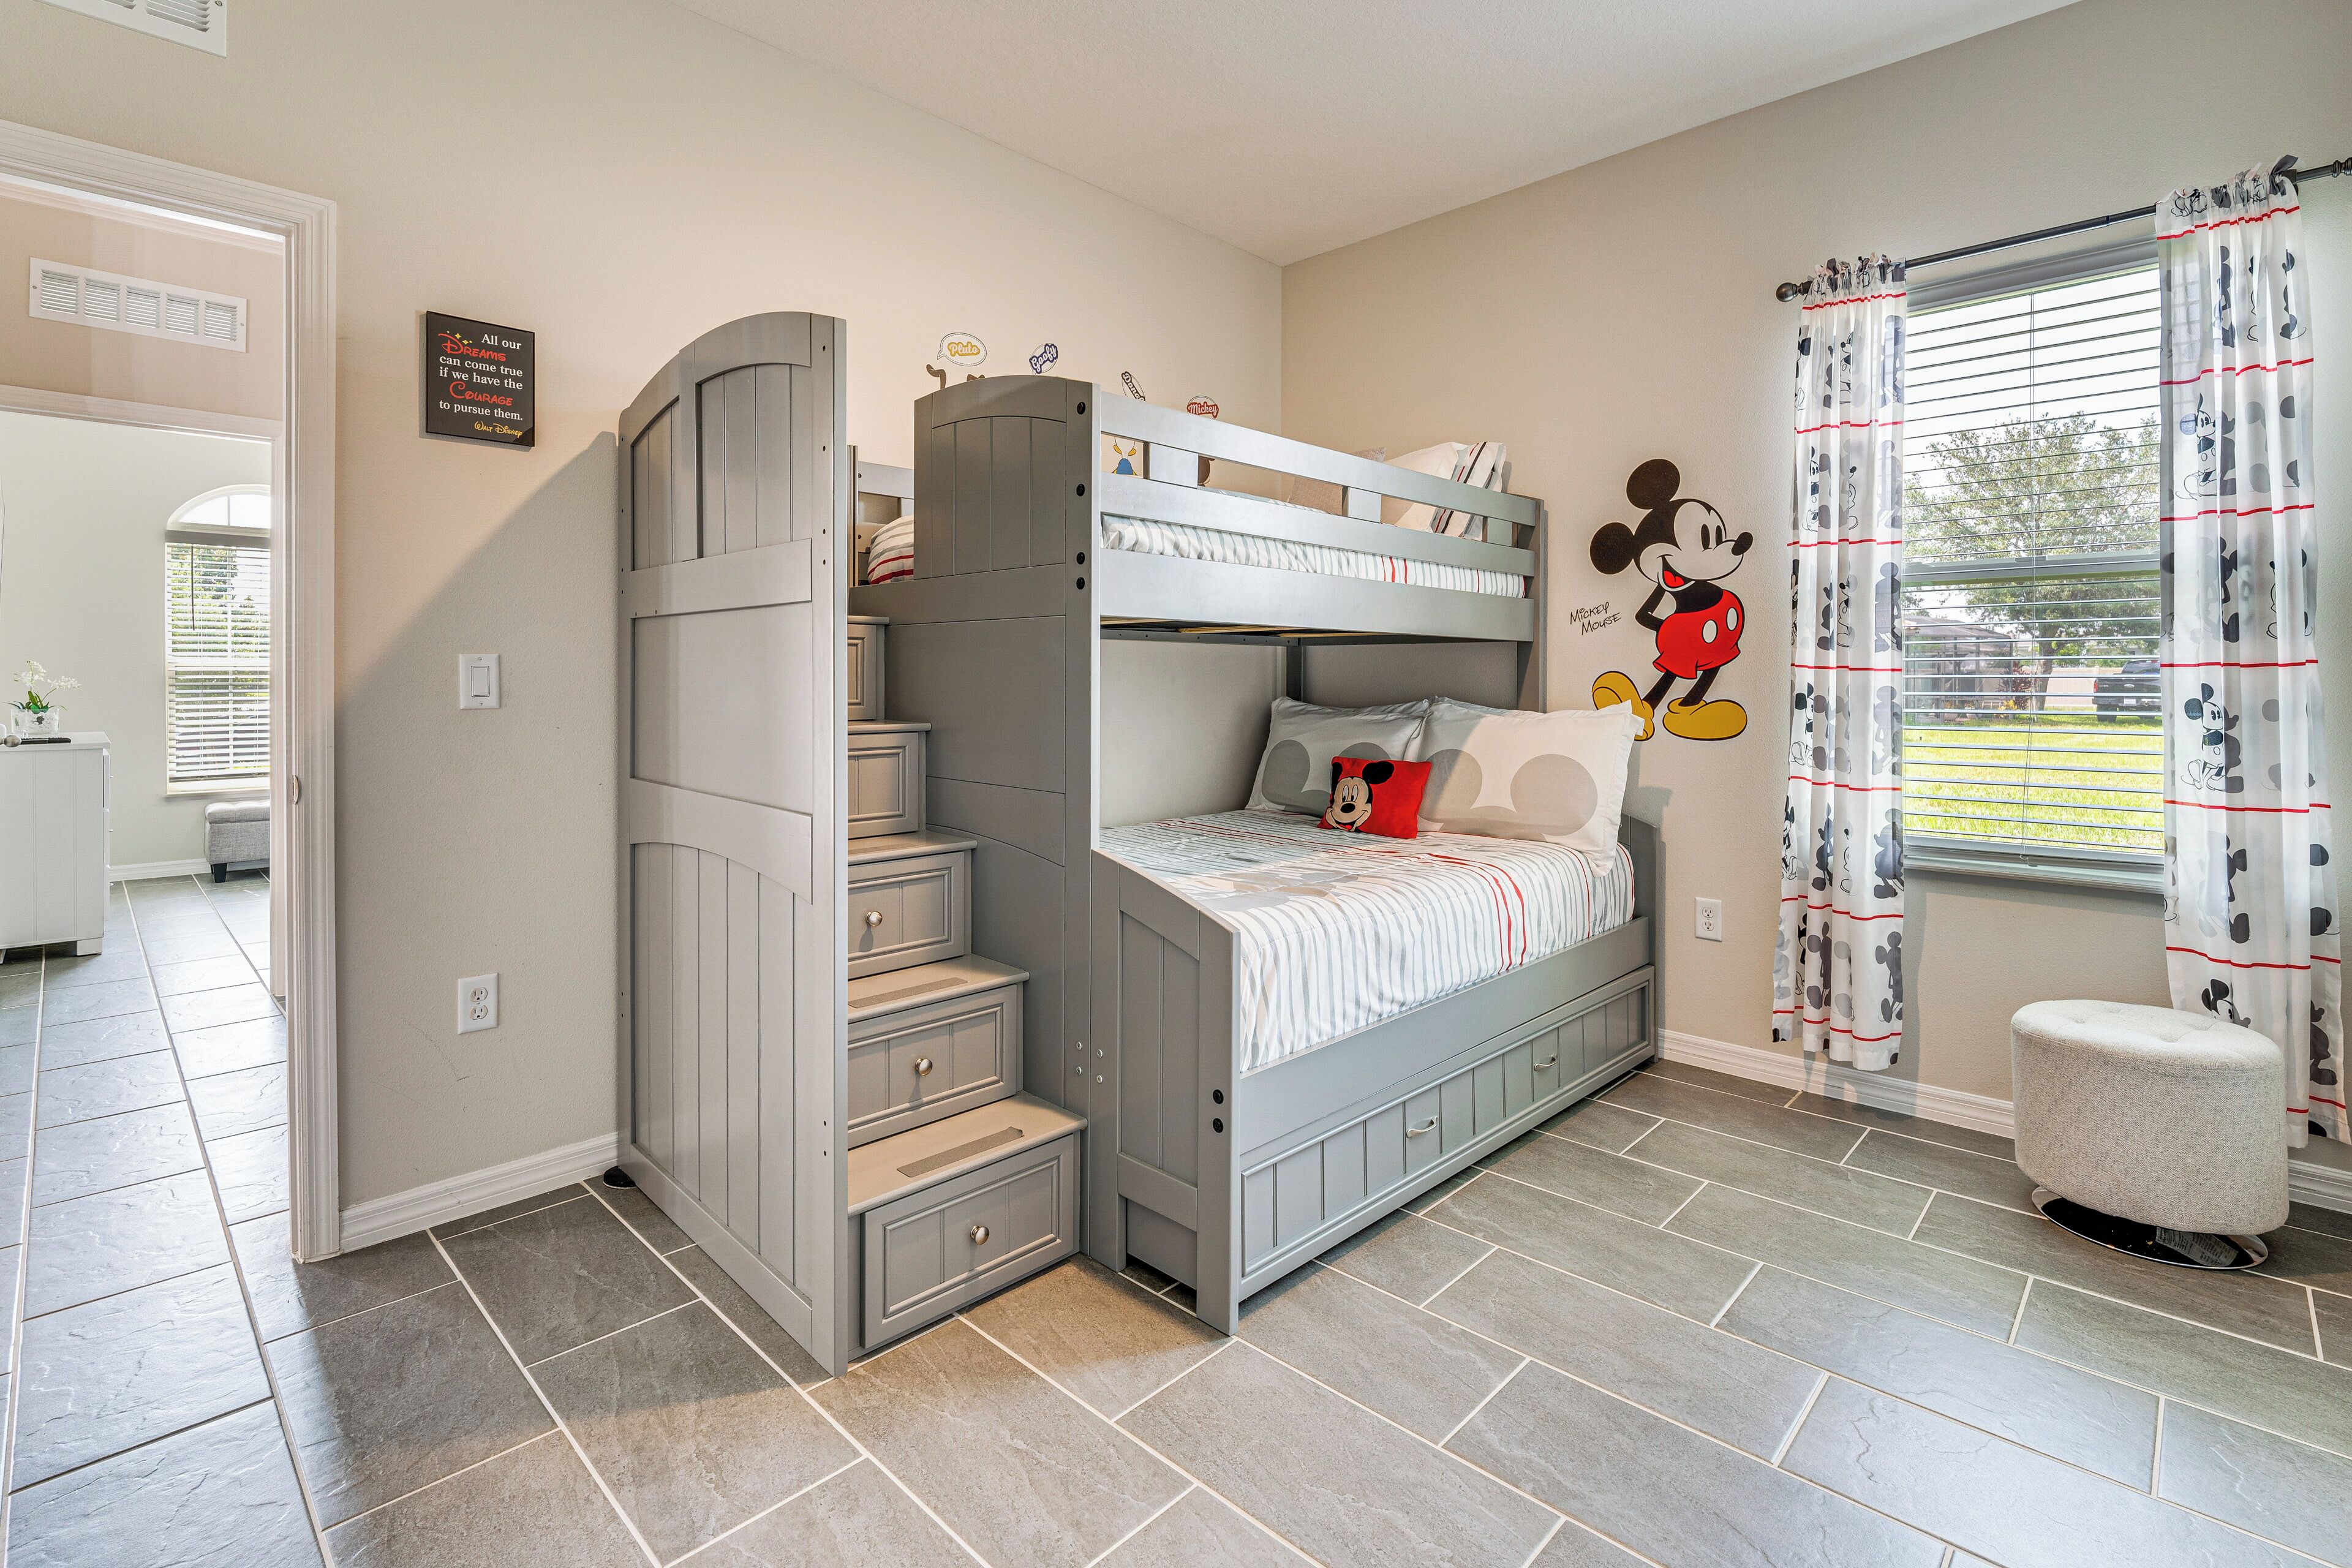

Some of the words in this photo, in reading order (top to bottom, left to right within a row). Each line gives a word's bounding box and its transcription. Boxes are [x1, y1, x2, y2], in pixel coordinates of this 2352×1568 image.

[481, 334, 497, 345] All
[502, 340, 522, 350] our
[949, 342, 979, 356] Pluto
[440, 356, 461, 366] can
[465, 361, 496, 372] come
[500, 365, 523, 377] true
[1030, 344, 1057, 373] Goofy
[440, 367, 448, 377] if
[451, 371, 469, 381] we
[473, 373, 500, 386] have
[504, 379, 523, 390] the
[439, 400, 450, 410] to
[454, 404, 491, 416] pursue
[494, 408, 523, 421] them.
[1188, 402, 1218, 417] Mickey
